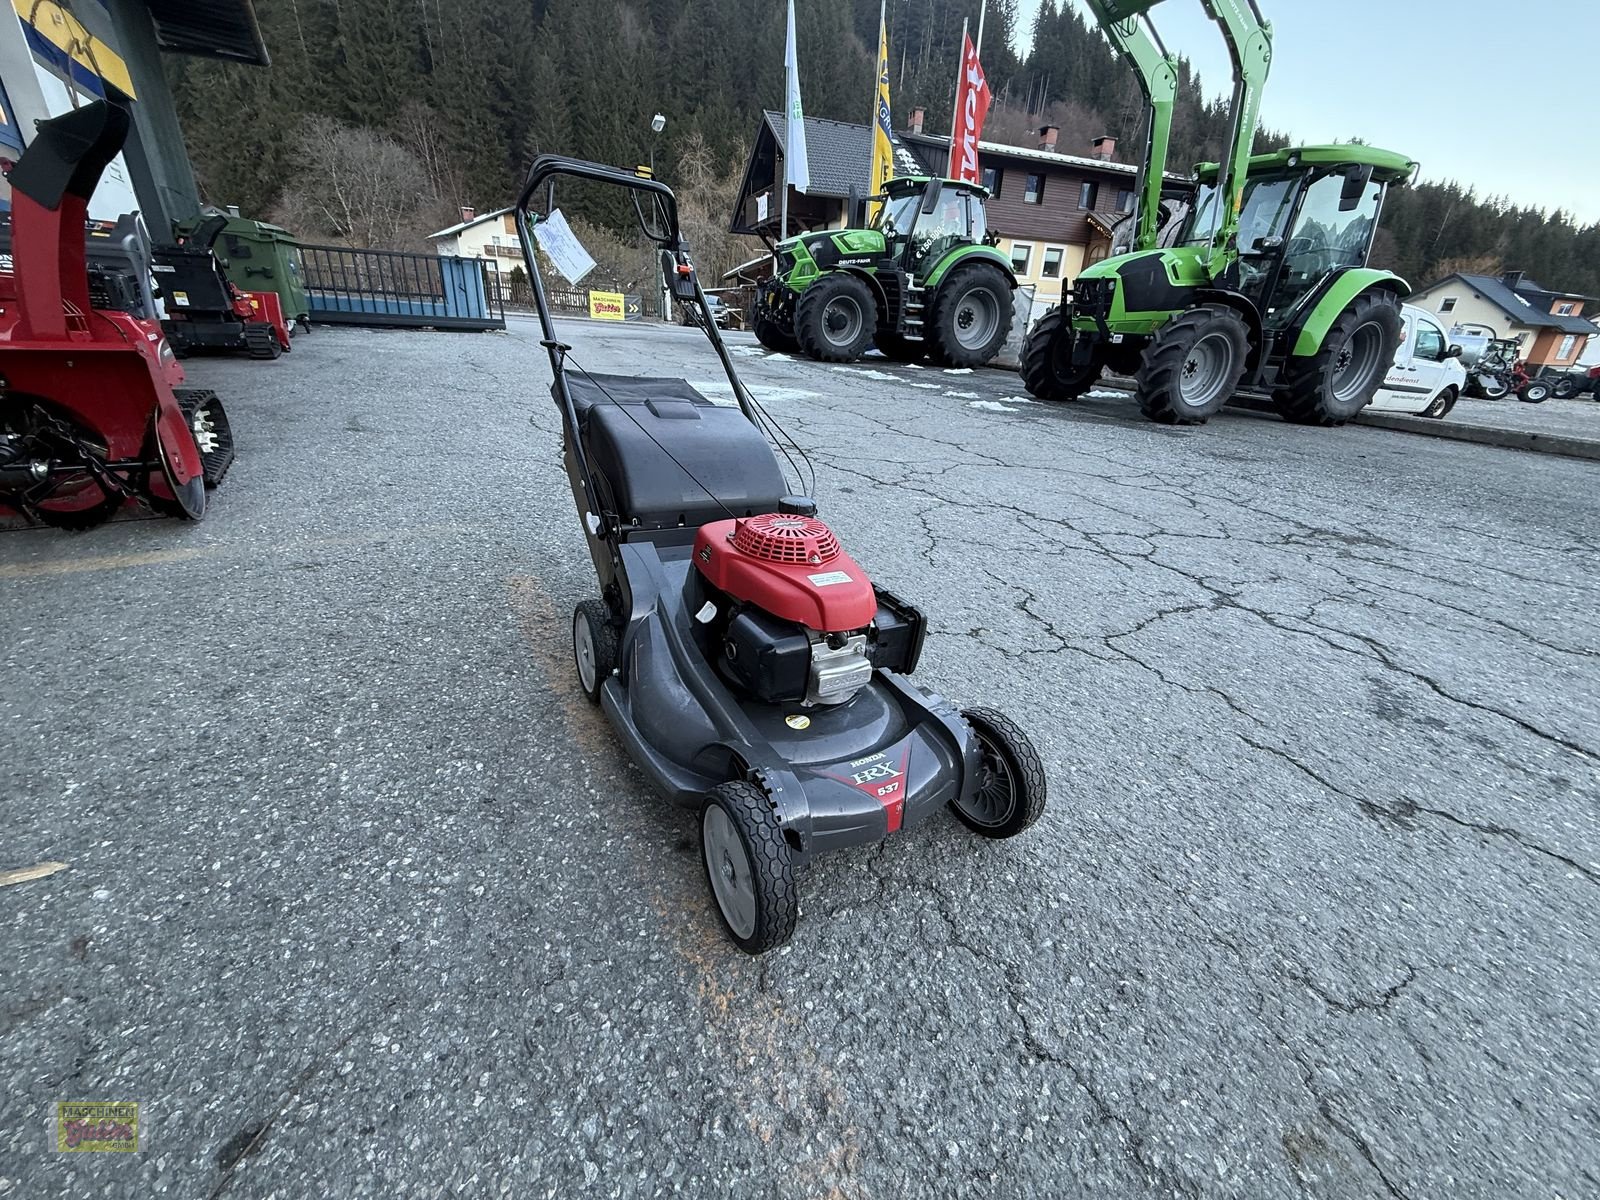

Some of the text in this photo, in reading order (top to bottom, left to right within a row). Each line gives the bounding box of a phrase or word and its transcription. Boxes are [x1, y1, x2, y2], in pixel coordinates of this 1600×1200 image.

[1386, 375, 1420, 384] dendienst
[849, 752, 887, 768] HONDA
[850, 760, 904, 786] HRX
[877, 782, 899, 796] 537
